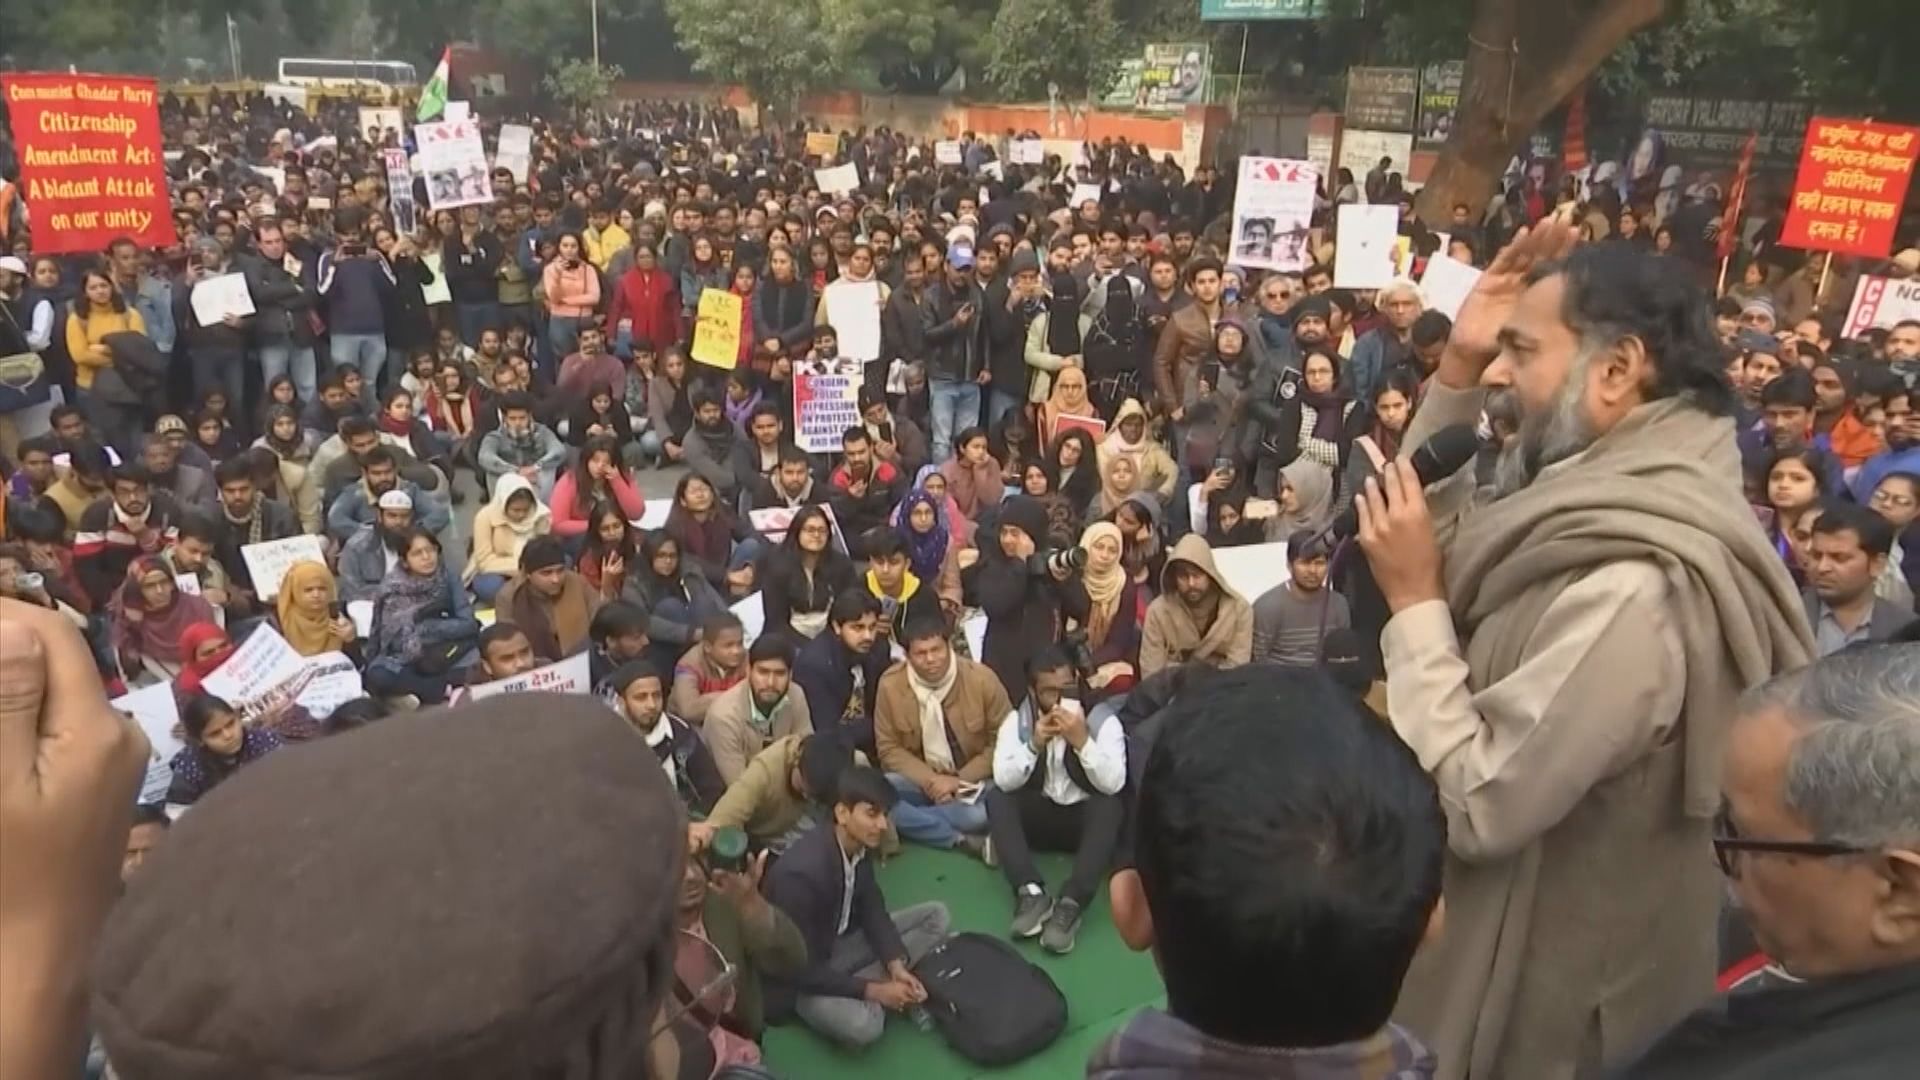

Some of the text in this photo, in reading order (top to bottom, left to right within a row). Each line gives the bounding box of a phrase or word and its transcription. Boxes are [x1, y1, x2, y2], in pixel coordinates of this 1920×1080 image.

[76, 82, 119, 100] Ghadar
[123, 86, 153, 106] Party
[39, 111, 137, 139] Citizenship
[25, 143, 156, 166] Amendment Act:
[1245, 159, 1317, 182] KYS
[30, 177, 155, 199] A blatant Attak
[52, 208, 151, 233] on our unity
[807, 377, 850, 388] CONDEMN
[814, 389, 844, 399] POLICE
[801, 412, 859, 422] ON PROTESTS
[802, 401, 856, 411] REPRESSION
[802, 425, 838, 435] AGAINST
